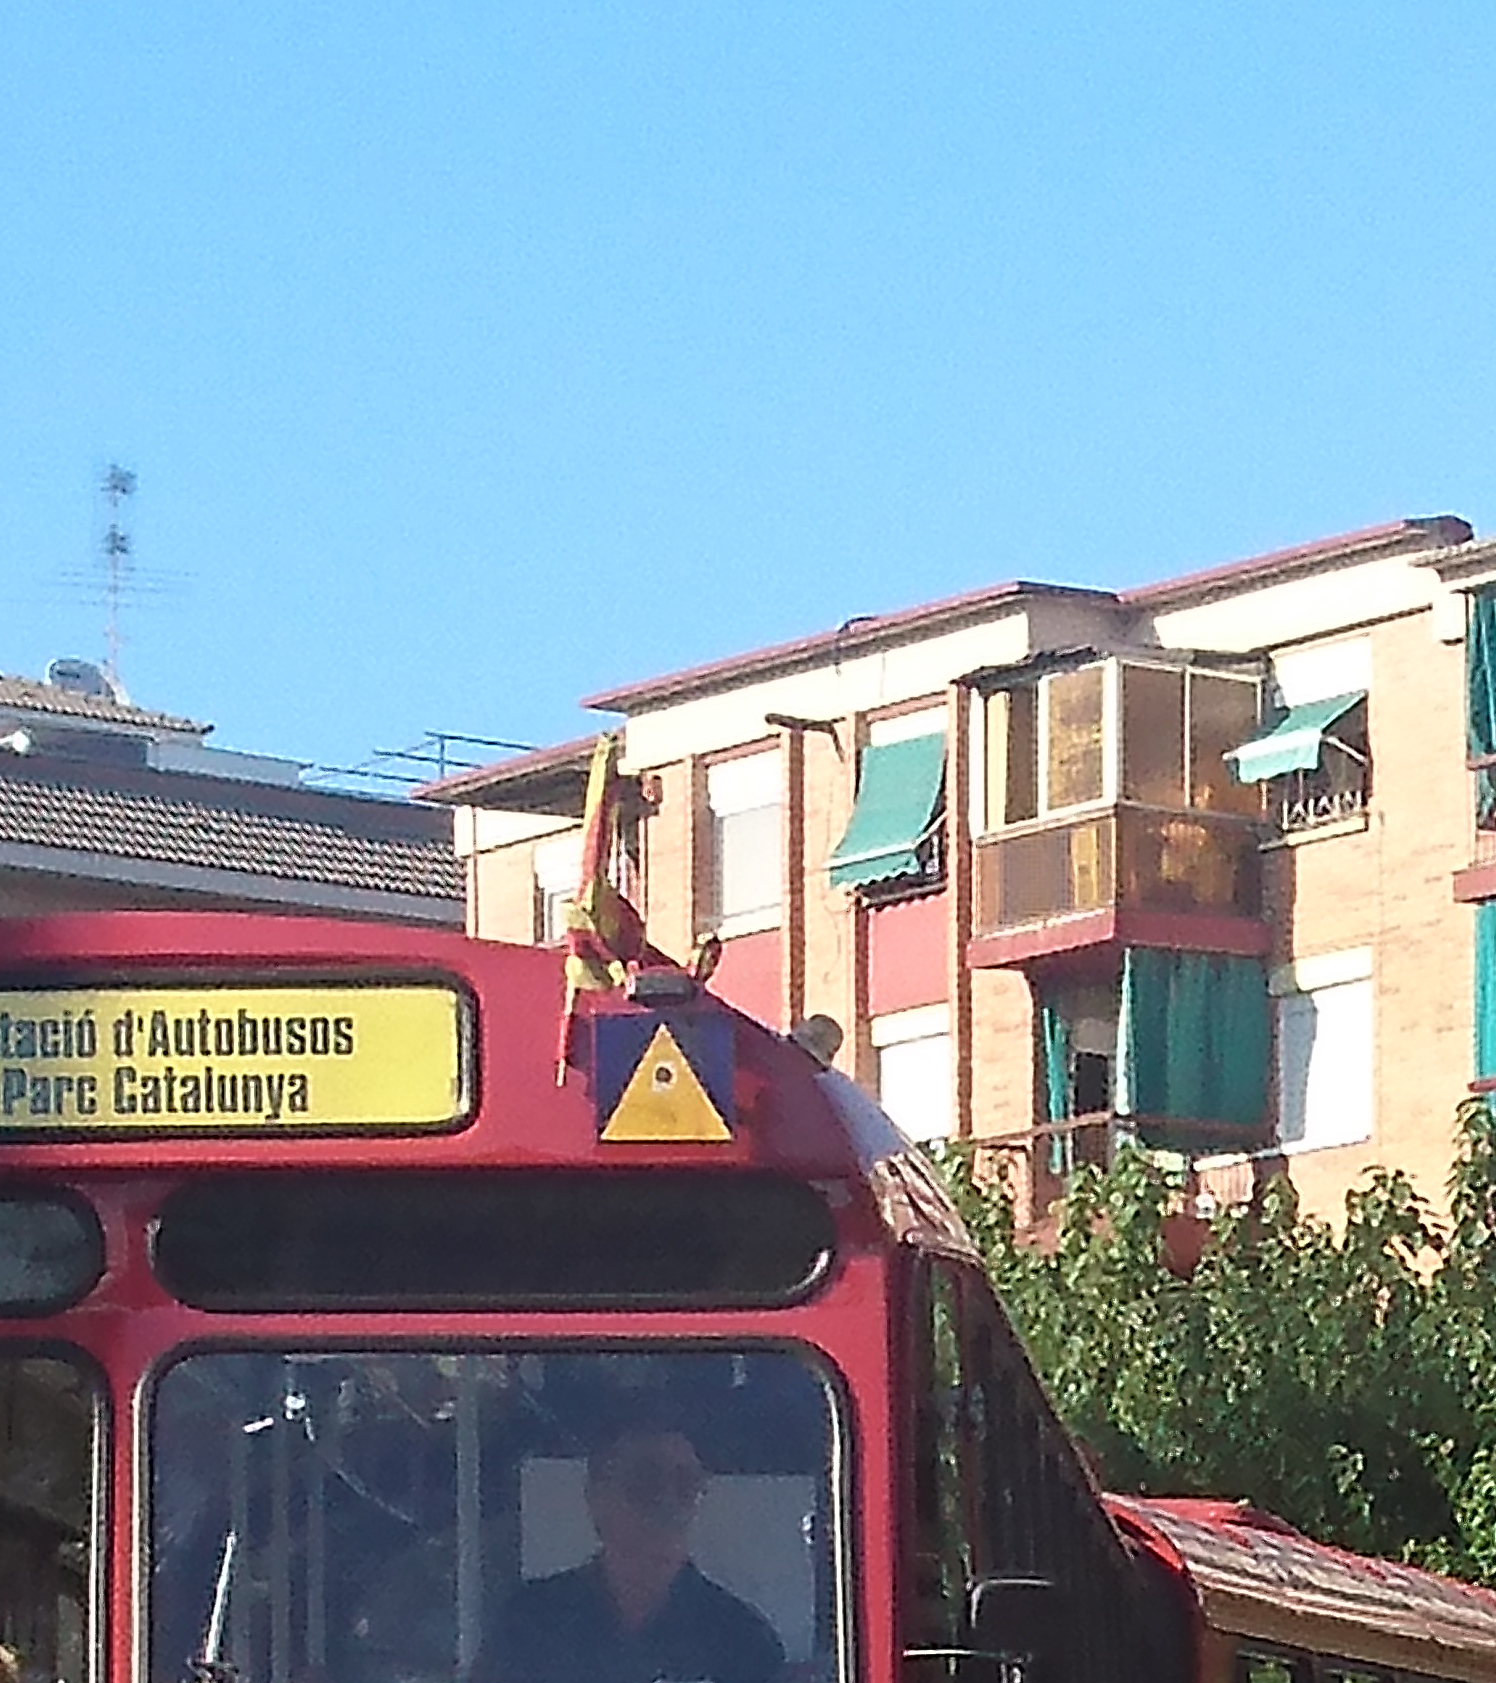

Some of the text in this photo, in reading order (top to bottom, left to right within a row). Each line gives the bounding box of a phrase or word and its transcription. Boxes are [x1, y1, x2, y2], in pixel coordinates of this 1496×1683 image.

[112, 1008, 355, 1058] d'Autobusos
[3, 1065, 310, 1120] Parc Catalunya
